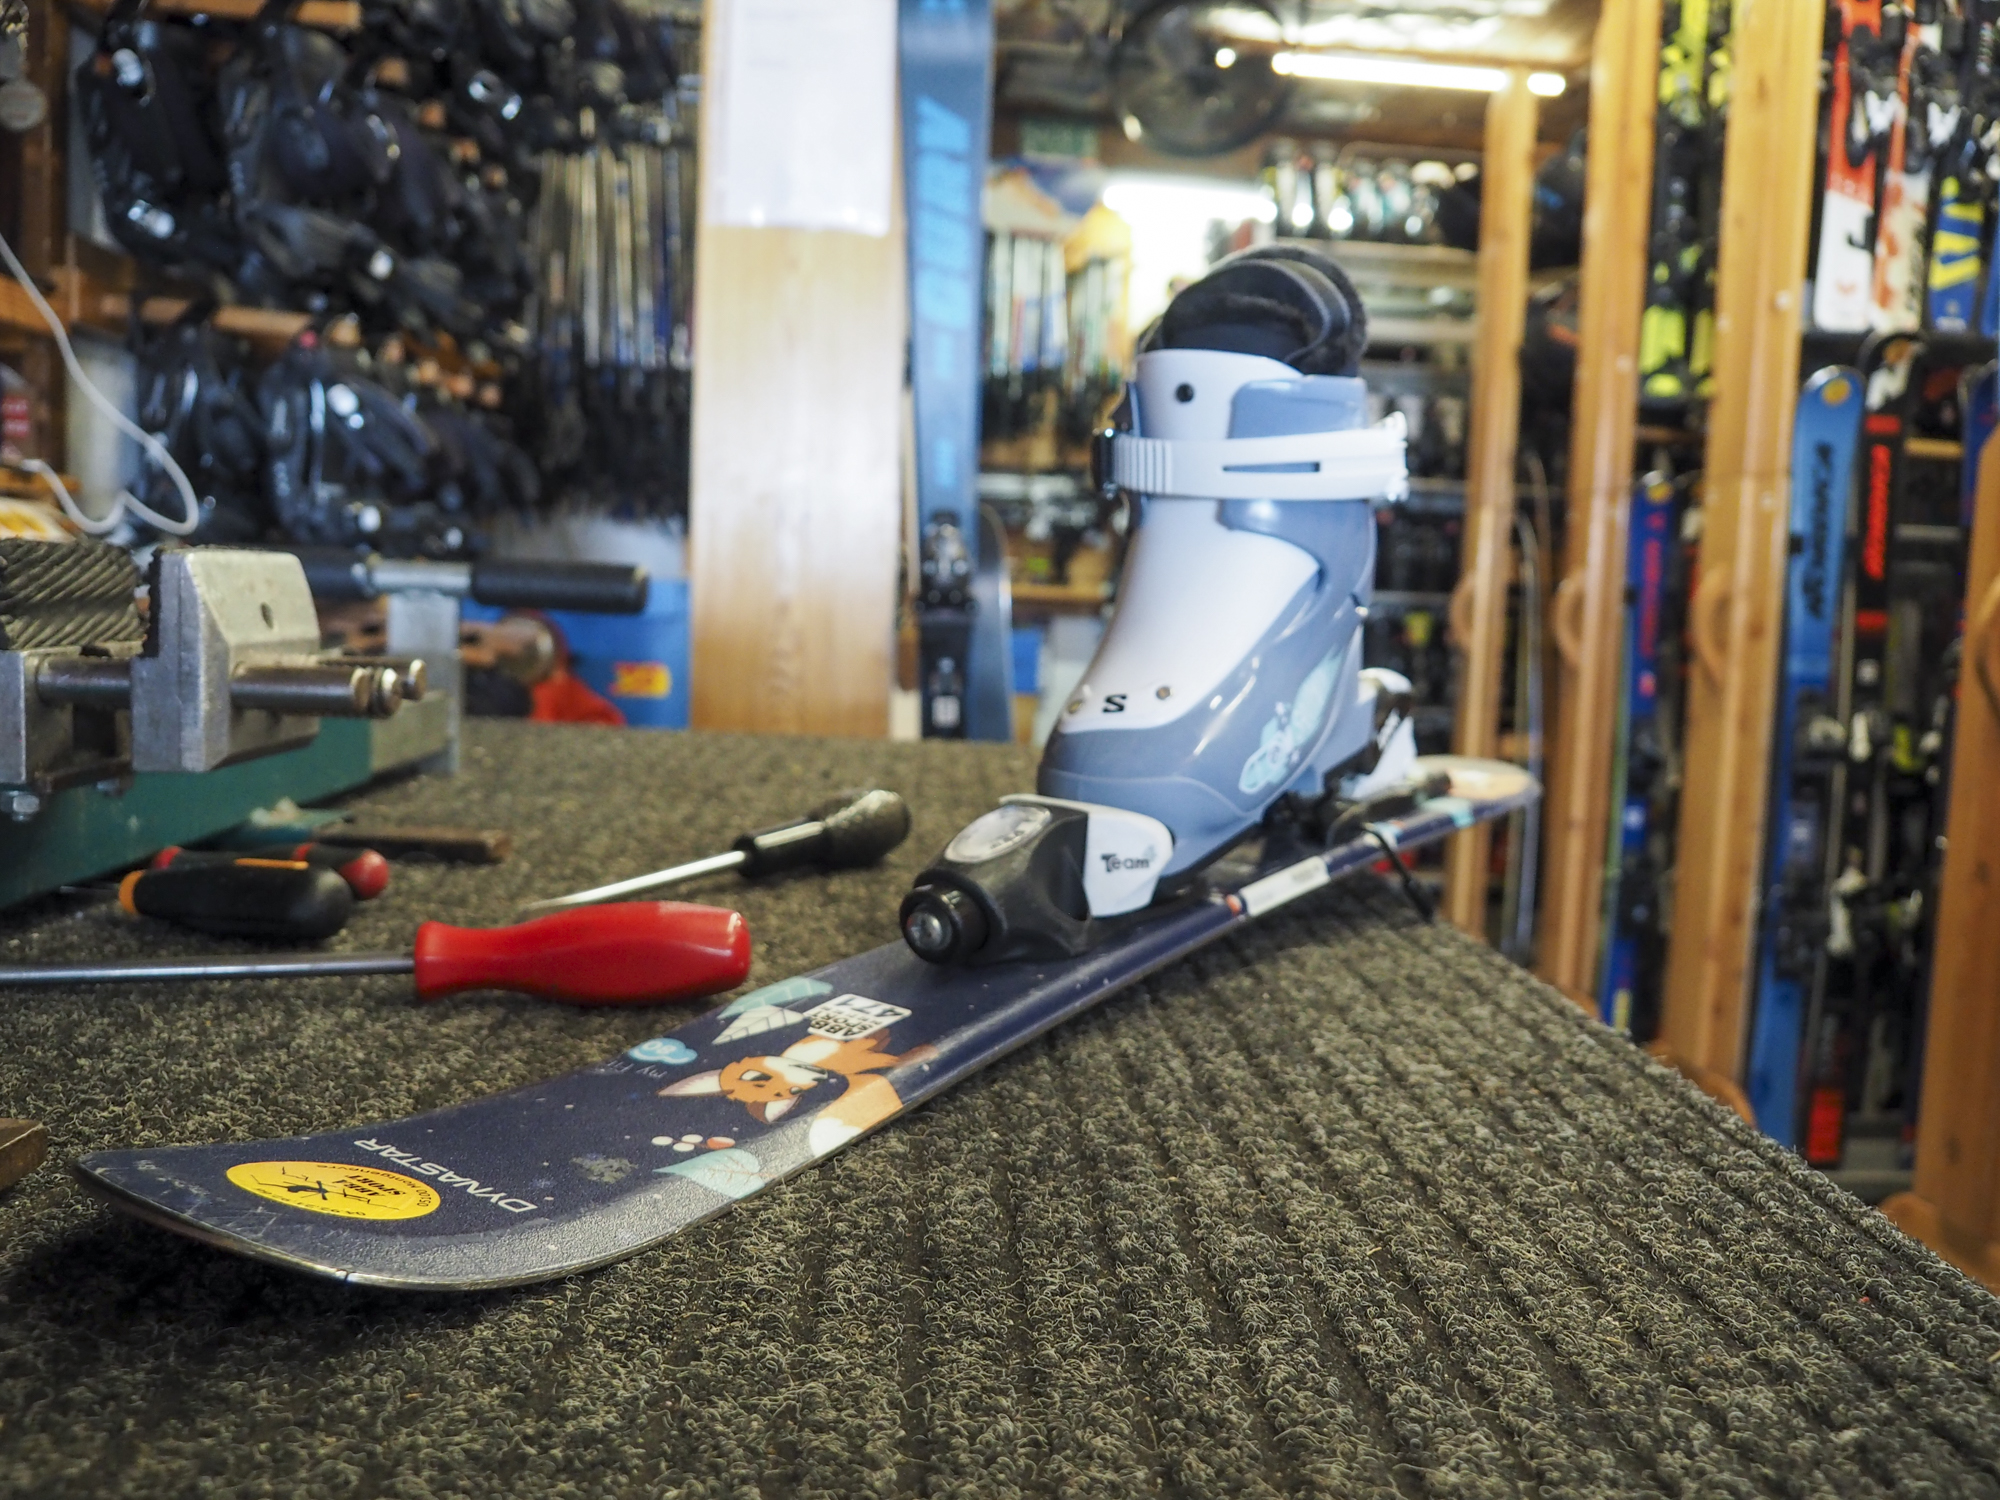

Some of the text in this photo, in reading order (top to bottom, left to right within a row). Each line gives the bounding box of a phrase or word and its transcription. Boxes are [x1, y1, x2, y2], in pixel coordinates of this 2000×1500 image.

[1102, 694, 1127, 713] S
[1101, 853, 1149, 872] Team
[835, 997, 903, 1018] 471
[809, 1018, 863, 1036] ABB
[345, 1175, 406, 1195] SPORT
[354, 1138, 539, 1213] DYNASTAR
[415, 1189, 432, 1207] 05100
